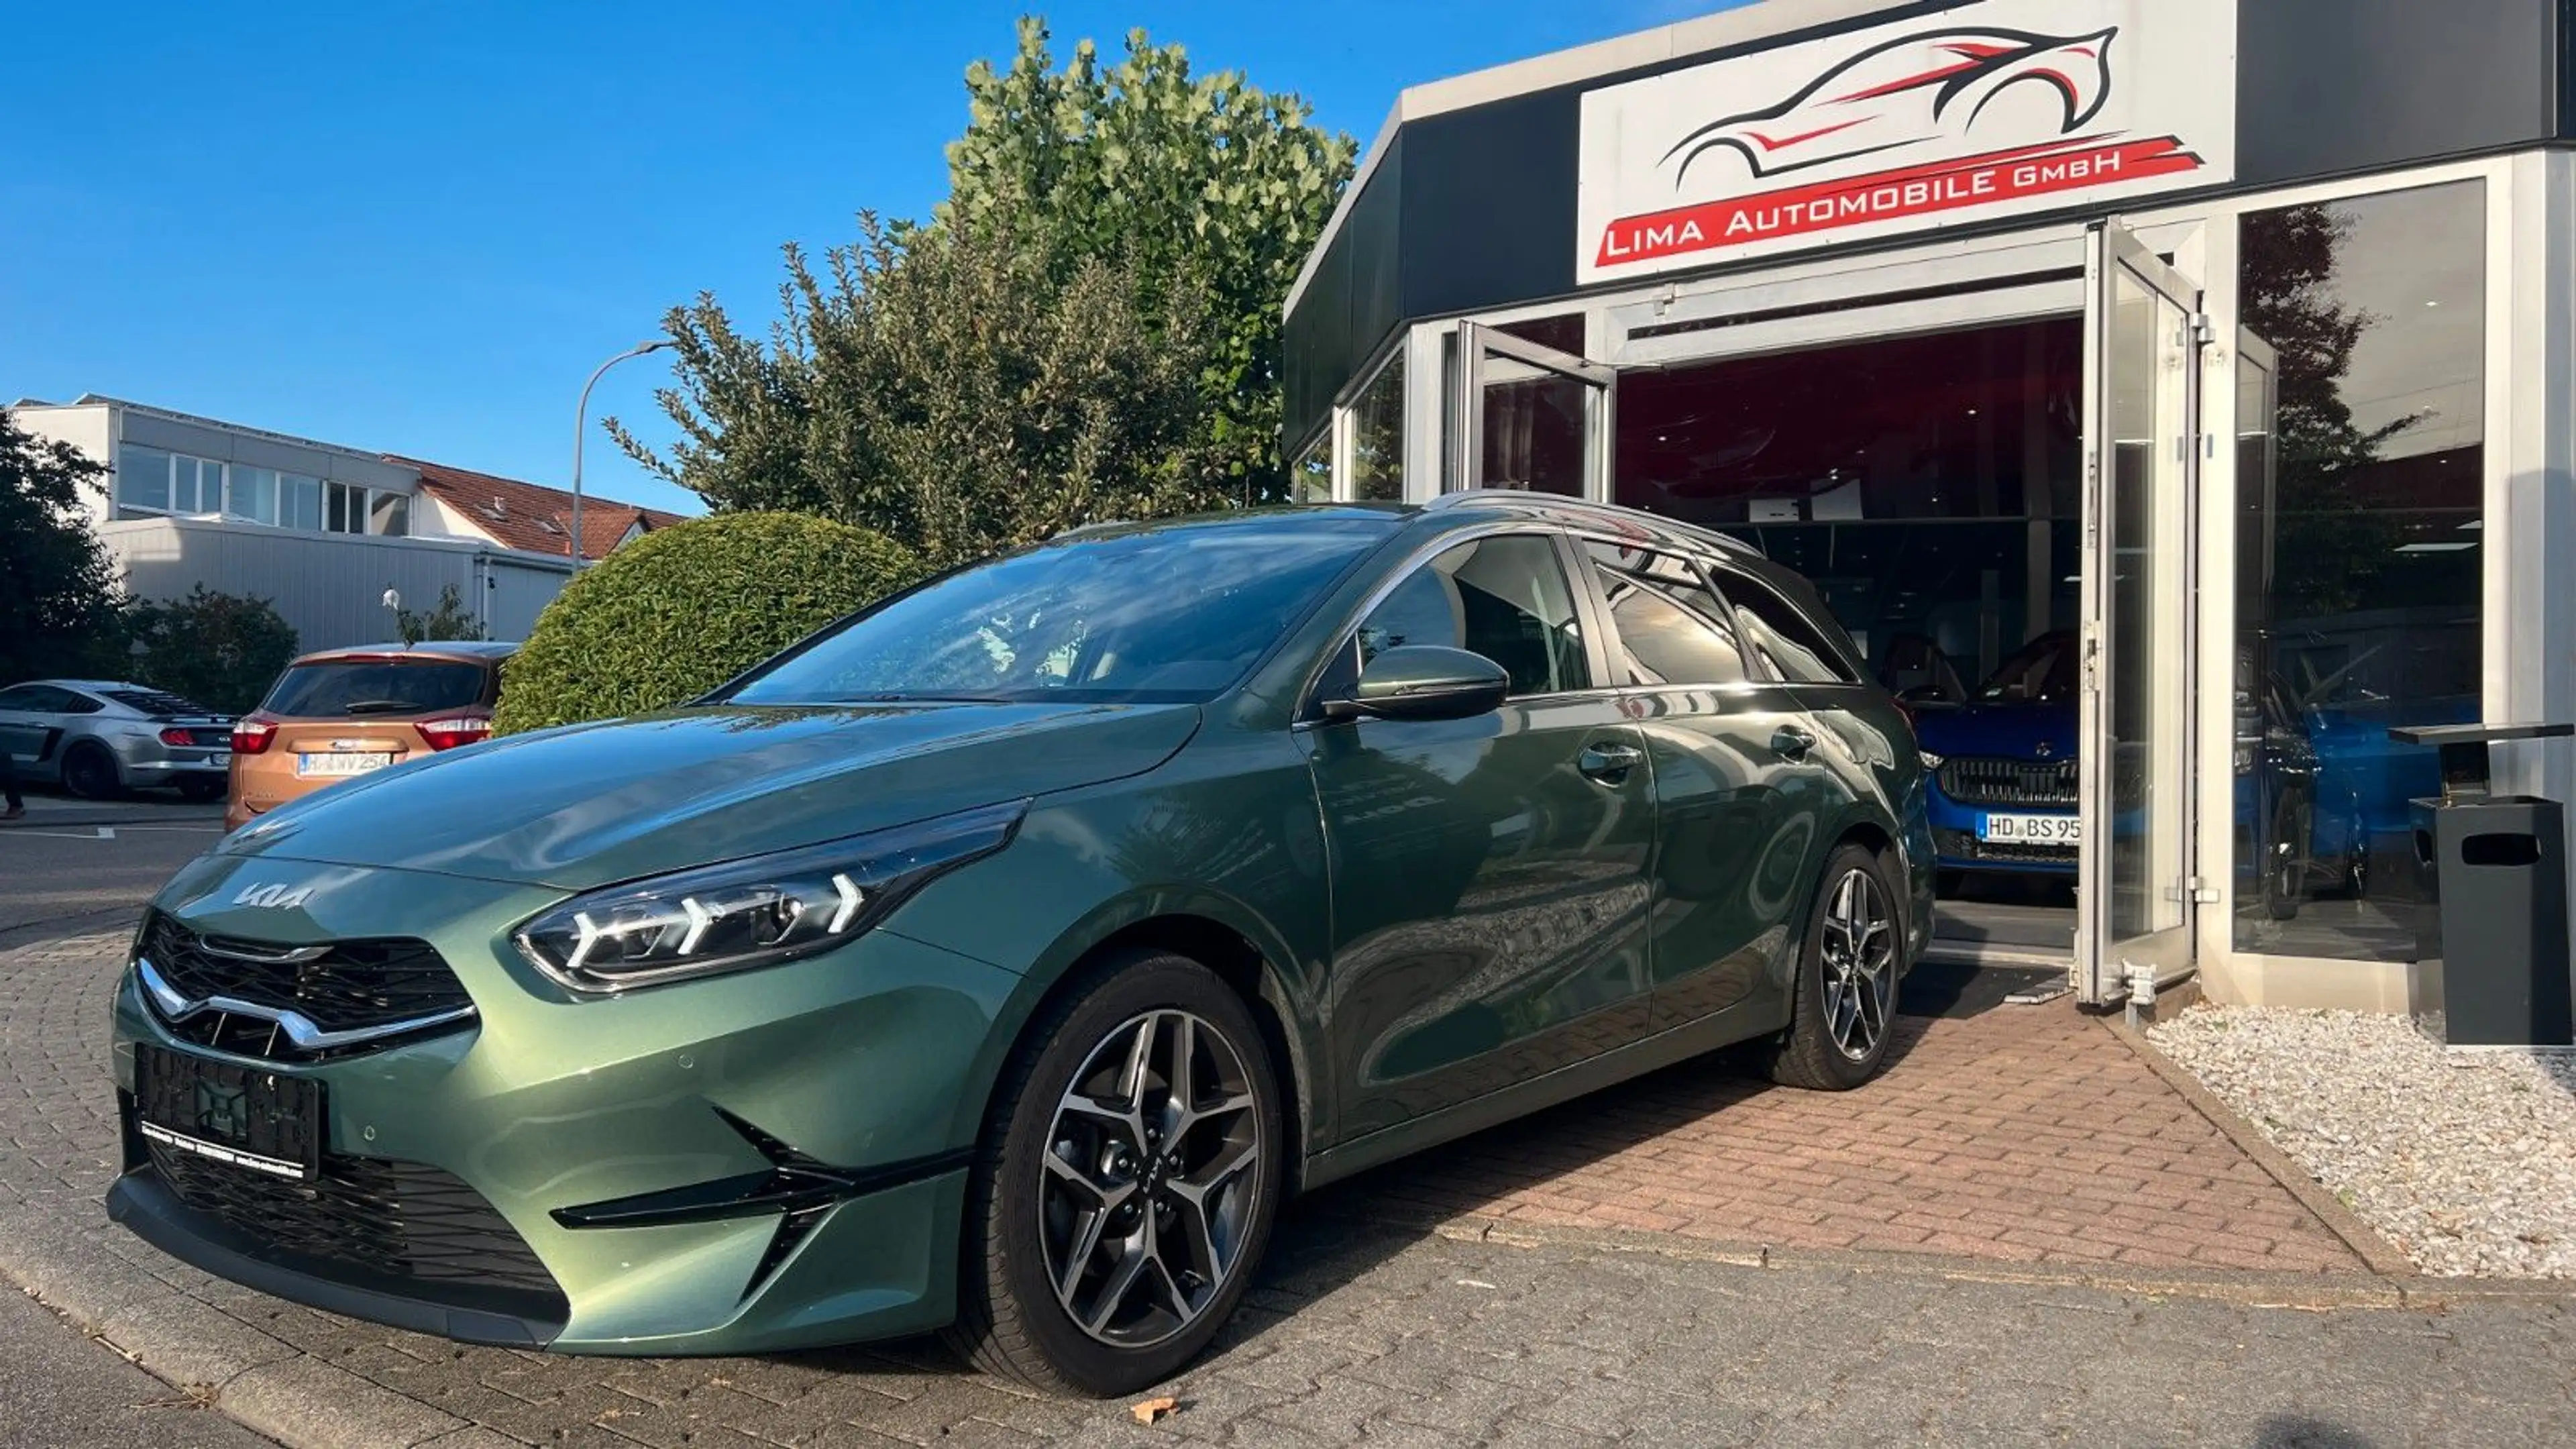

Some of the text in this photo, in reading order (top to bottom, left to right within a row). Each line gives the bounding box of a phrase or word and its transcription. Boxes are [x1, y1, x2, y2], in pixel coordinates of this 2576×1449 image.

[1607, 220, 1705, 256] LIMA
[1725, 170, 1996, 236] AUTOMOBILE
[1990, 818, 2013, 836] HD
[2027, 818, 2052, 837] BS
